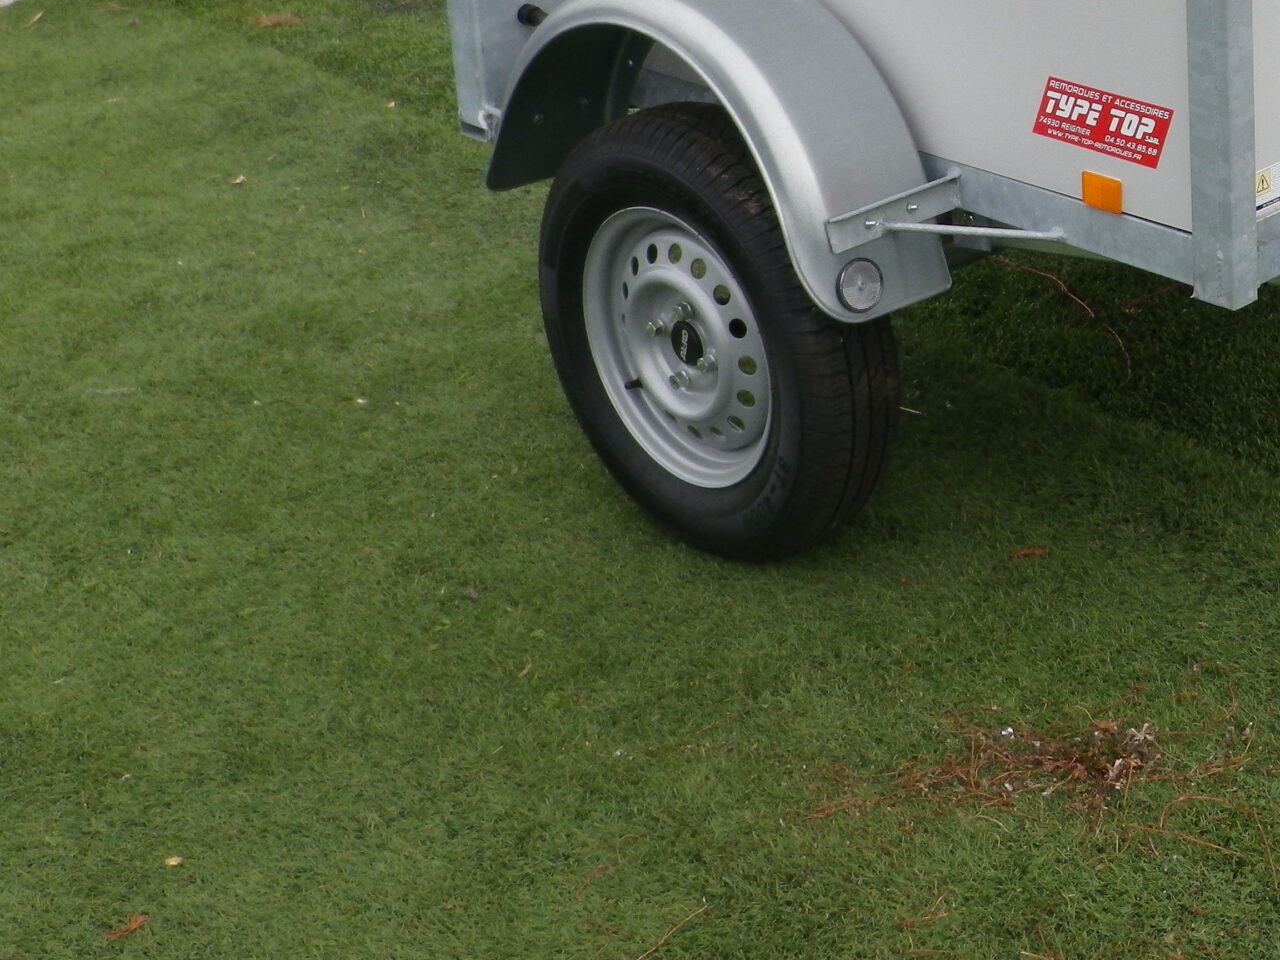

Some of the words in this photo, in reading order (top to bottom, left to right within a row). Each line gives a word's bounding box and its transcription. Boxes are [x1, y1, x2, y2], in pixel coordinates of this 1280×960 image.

[1045, 90, 1103, 127] TYPE
[1109, 108, 1156, 140] TOP
[1049, 80, 1101, 100] REMORQUES
[1102, 94, 1113, 104] ET
[1114, 98, 1170, 120] ACCESSOIRES
